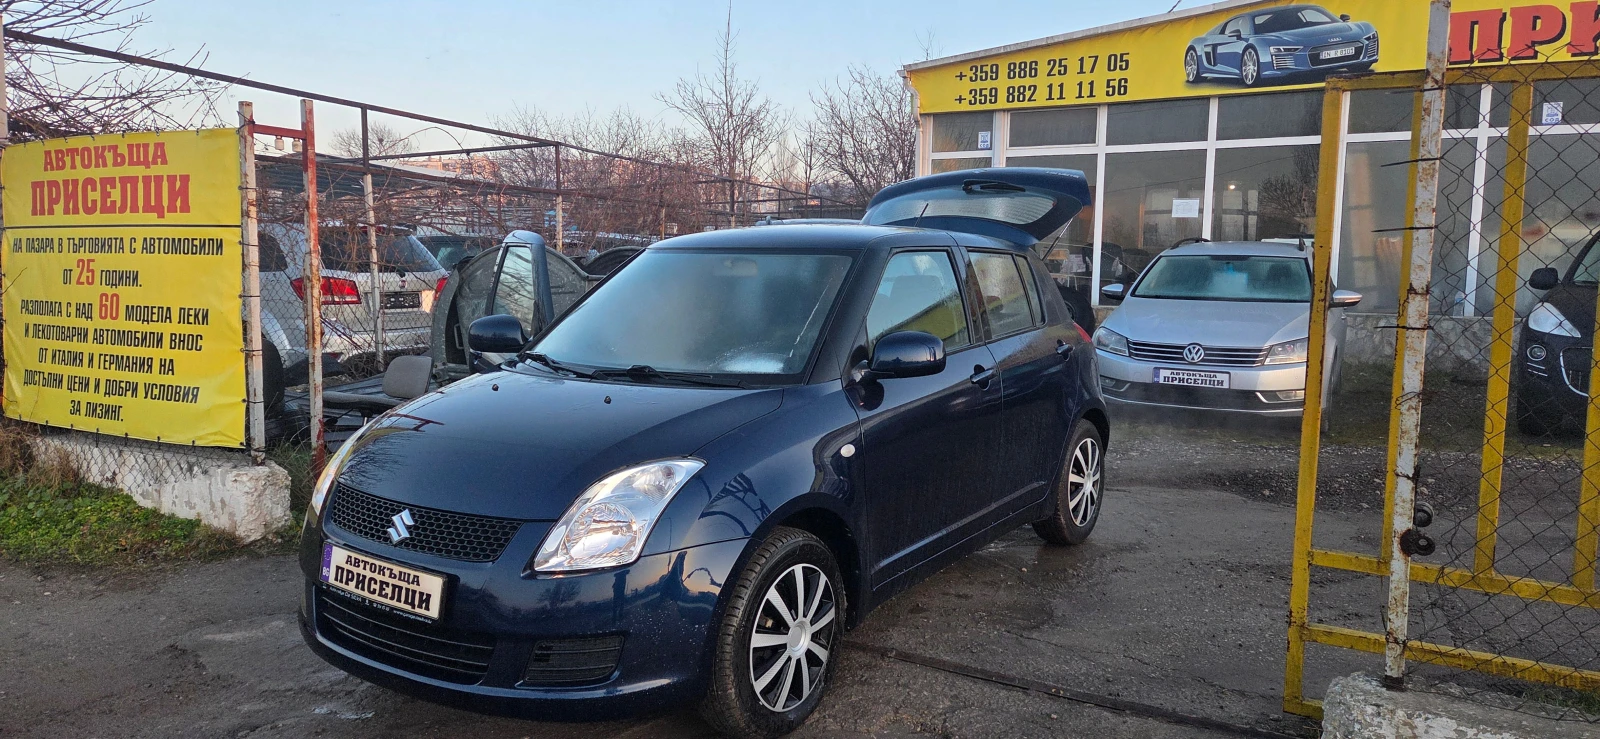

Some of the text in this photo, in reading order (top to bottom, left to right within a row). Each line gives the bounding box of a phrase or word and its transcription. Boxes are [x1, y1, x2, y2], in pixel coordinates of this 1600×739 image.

[955, 53, 1130, 82] +359 886 25 17 05
[955, 78, 1128, 105] +359 882 11 11 56
[44, 142, 168, 171] АВТОКЪЩА
[31, 174, 190, 218] ПРИСЕЛЦИ
[13, 238, 223, 255] НА ПАЗАРА В ТЪРГОВИЯТА С АВТОМОБИЛИ
[63, 259, 142, 288] ОТ 25 ГОДИНИ.
[21, 293, 209, 325] РАЗПОЛАГА С НАД 60 МОДЕЛА ЛЕКИ
[25, 323, 203, 351] И ЛЕКОТОВАРНИ АВТОМОБИЛИ ВНОС
[39, 348, 175, 376] ОТ ИТАЛИЯ И ГЕРМАНИЯ НА
[24, 369, 199, 404] ДОСТЪПНИ ЦЕНИ И ДОБРИ УСЛОВИЯ
[1163, 376, 1224, 387] ПРИСЕЛЦИ
[70, 400, 123, 422] ЗА ЛИЗИНГ.
[322, 566, 330, 577] BG
[346, 555, 420, 586] АВТОКЪЩА
[334, 565, 432, 612] ПРИСЕЛЦИ
